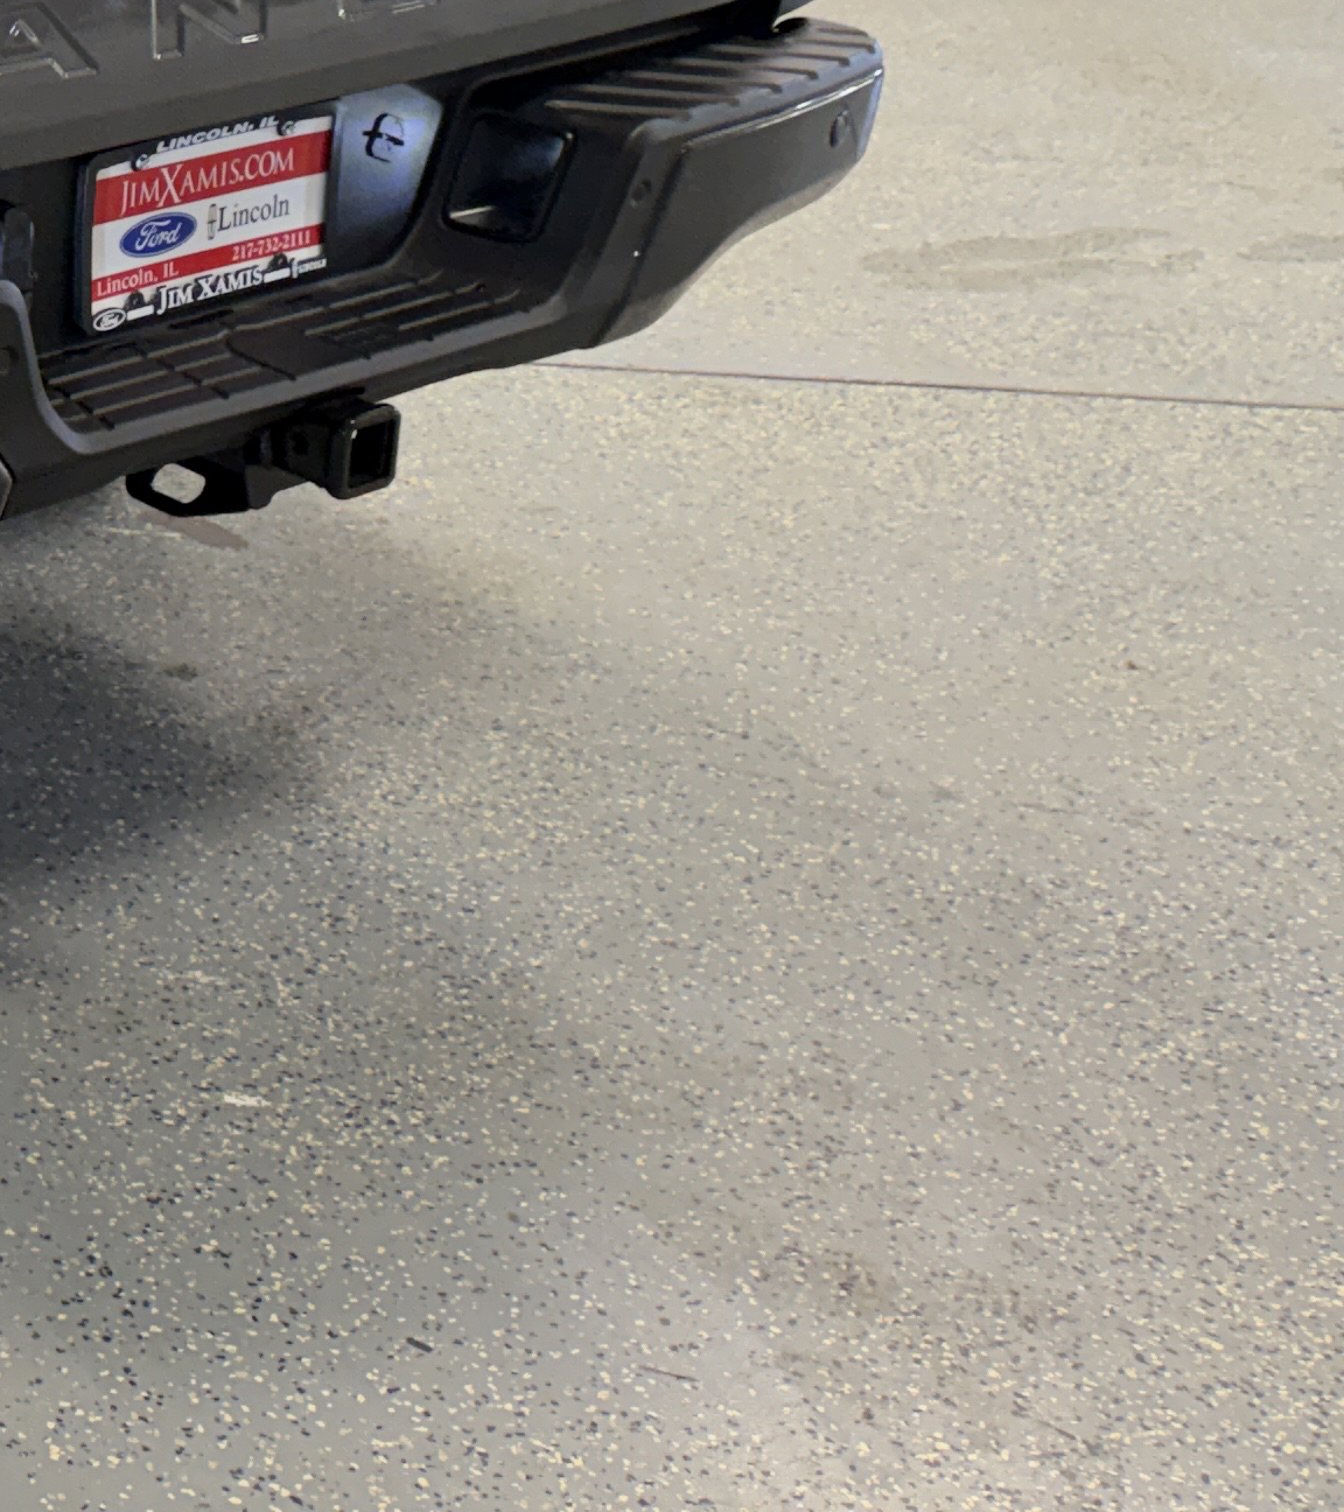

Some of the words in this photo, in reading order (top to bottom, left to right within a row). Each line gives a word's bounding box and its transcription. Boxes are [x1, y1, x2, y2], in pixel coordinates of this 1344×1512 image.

[258, 115, 279, 129] IL
[120, 147, 294, 217] JIMXAMIS.COM
[218, 194, 289, 231] Lincoln
[232, 229, 311, 261] 217-732-2111
[163, 261, 179, 279] IL
[156, 285, 194, 316] JIM
[197, 266, 263, 301] XAMIS
